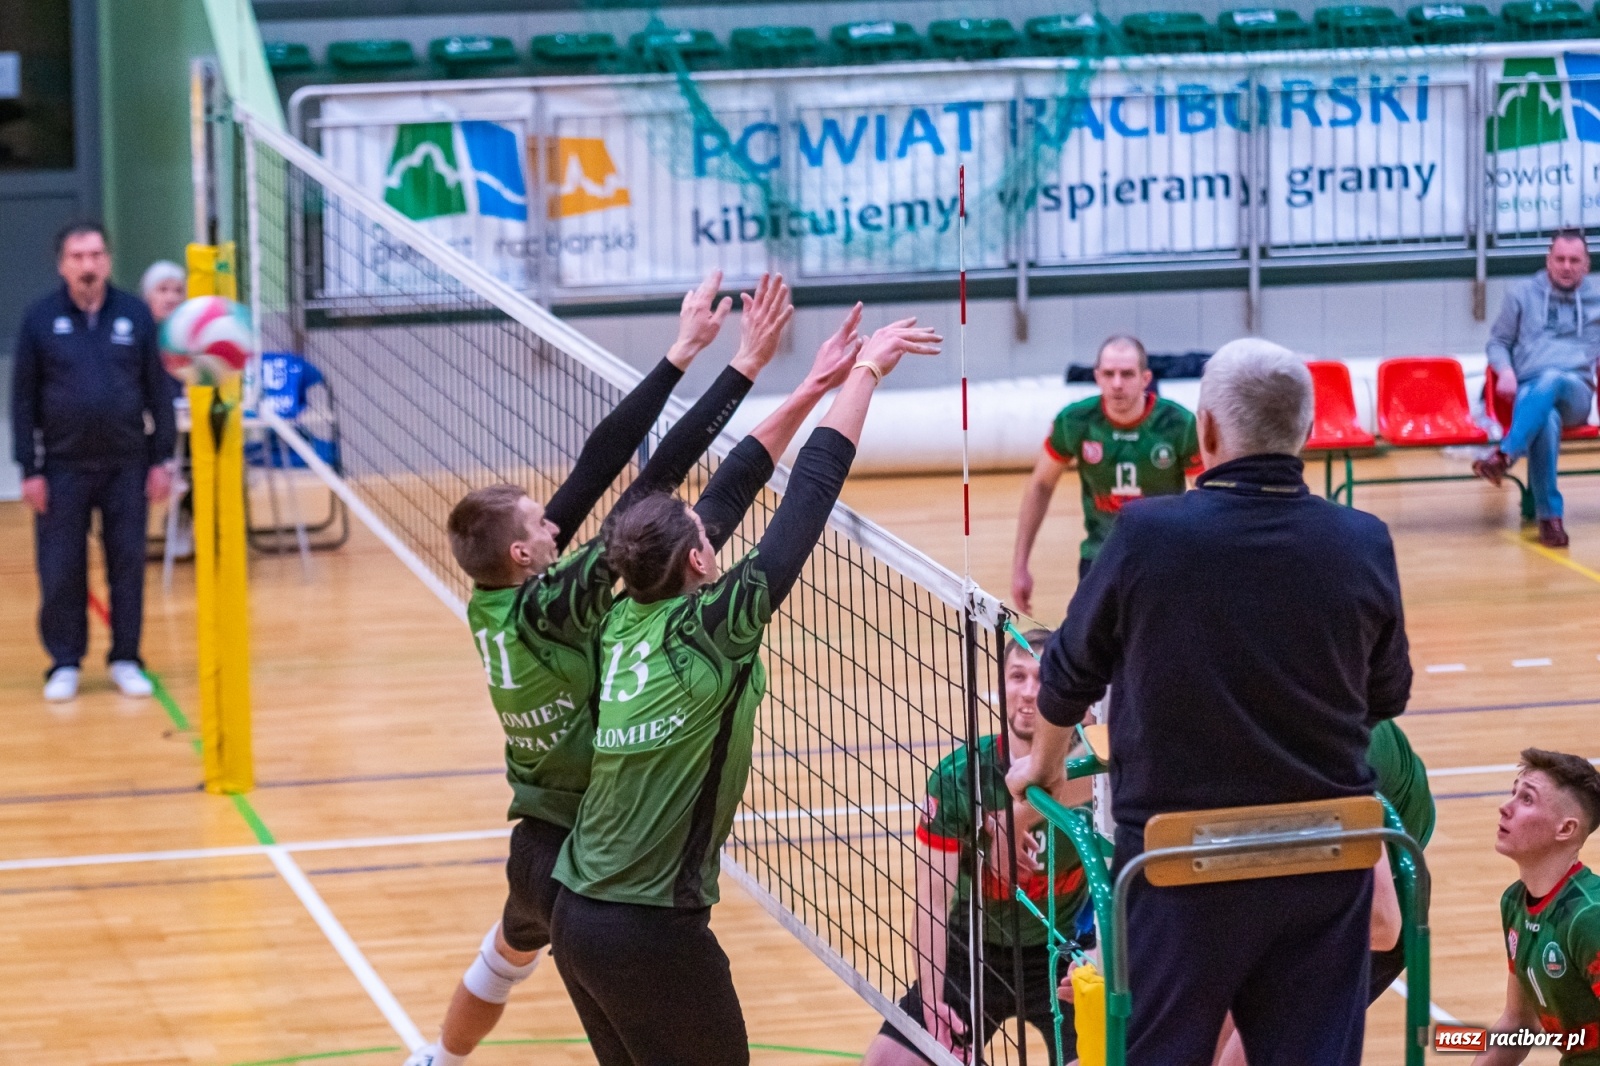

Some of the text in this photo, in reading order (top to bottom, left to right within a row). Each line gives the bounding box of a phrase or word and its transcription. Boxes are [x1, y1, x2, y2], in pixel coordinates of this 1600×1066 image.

[693, 100, 983, 177] POWIAT
[1286, 162, 1436, 208] gramy
[475, 628, 521, 689] 11
[600, 641, 650, 702] 13
